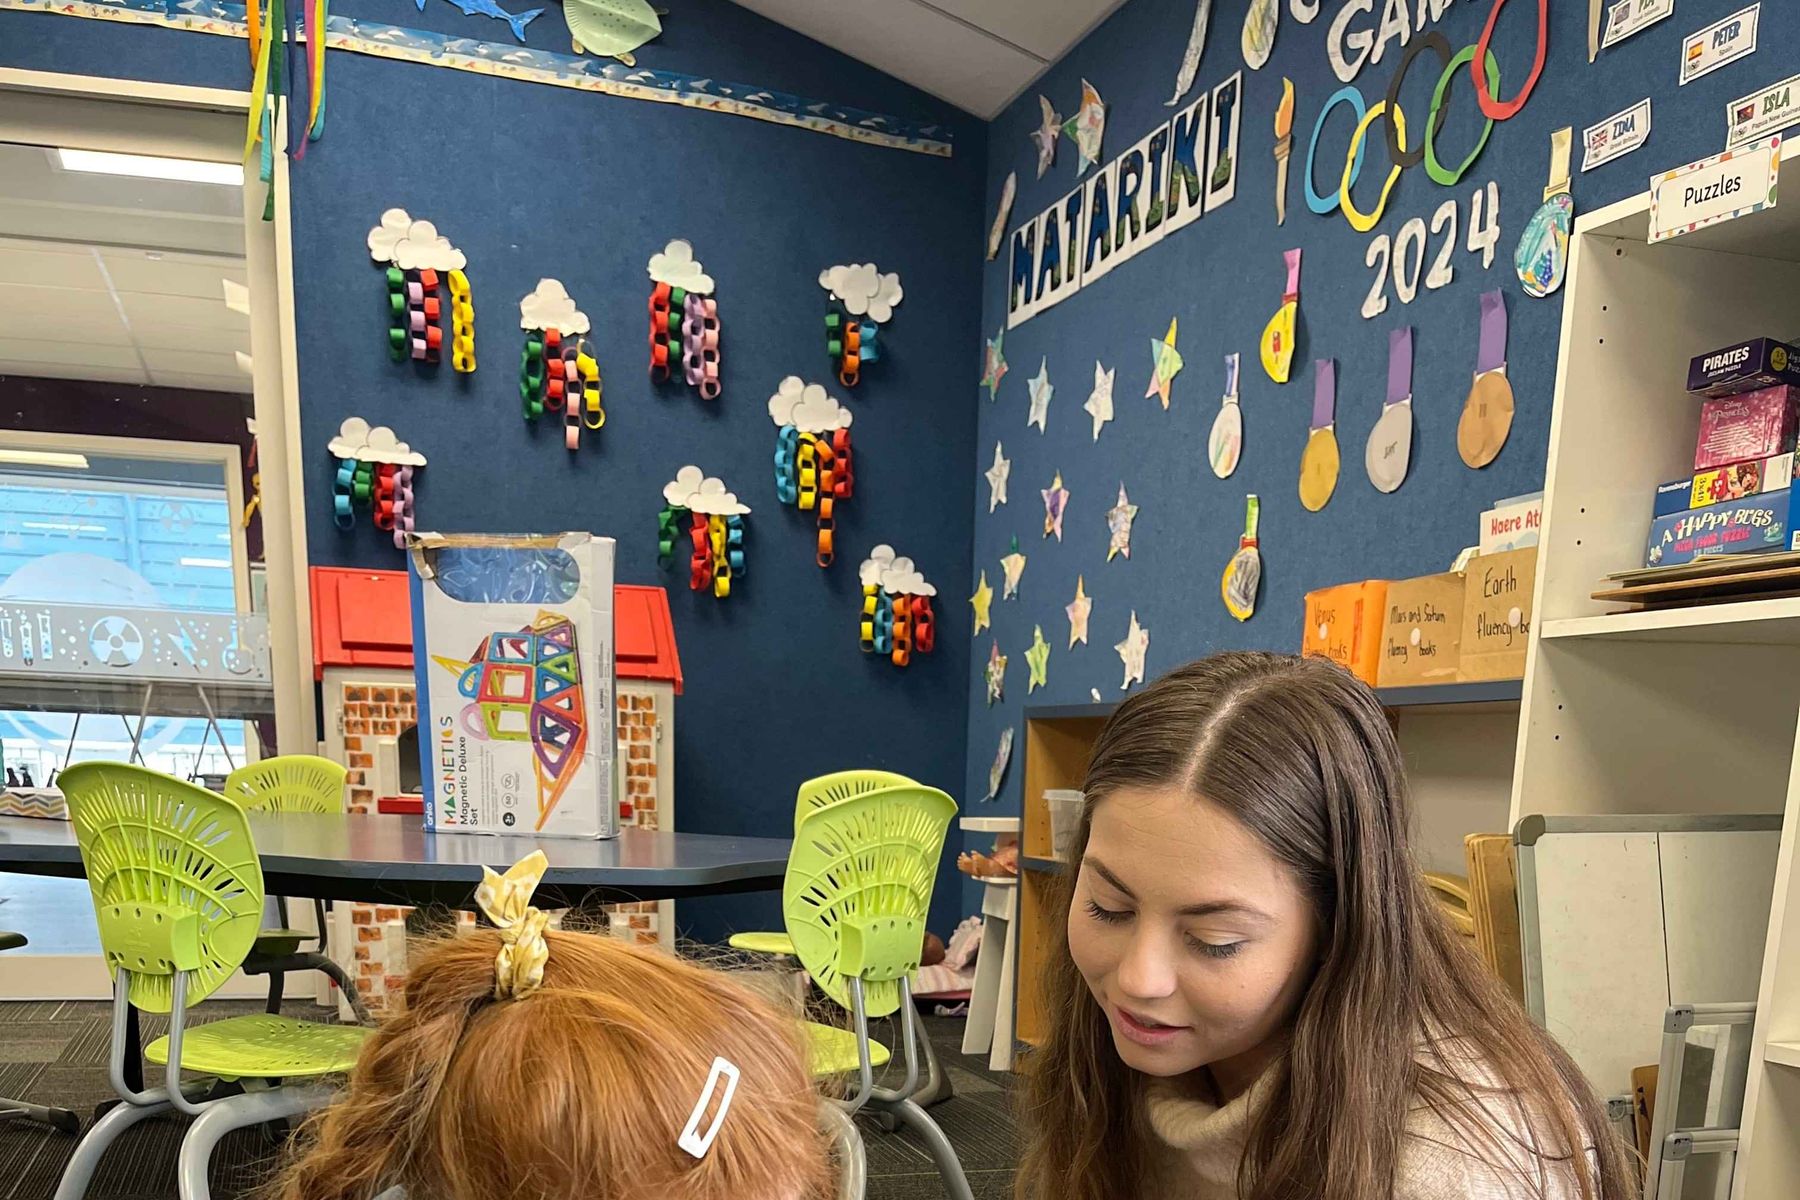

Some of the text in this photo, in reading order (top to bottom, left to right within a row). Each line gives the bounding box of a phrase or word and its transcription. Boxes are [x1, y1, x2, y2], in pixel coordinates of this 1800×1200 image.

[1712, 20, 1742, 50] PETER
[1762, 87, 1791, 116] ISLA
[1768, 112, 1781, 123] New
[1010, 82, 1238, 314] MATARIKI
[1684, 174, 1742, 208] Puzzles
[1361, 180, 1501, 319] 2024
[1702, 346, 1750, 373] PIRATES
[1491, 515, 1522, 537] Haere
[1661, 508, 1773, 547] A HAPPY BUGS
[1484, 565, 1517, 599] Earth
[1408, 605, 1422, 624] and
[1424, 603, 1446, 625] Saturn
[1476, 611, 1513, 647] fluency
[1419, 639, 1437, 657] books
[458, 736, 470, 826] Magnetic Deluxe
[425, 801, 434, 827] anko
[470, 808, 478, 826] Set
